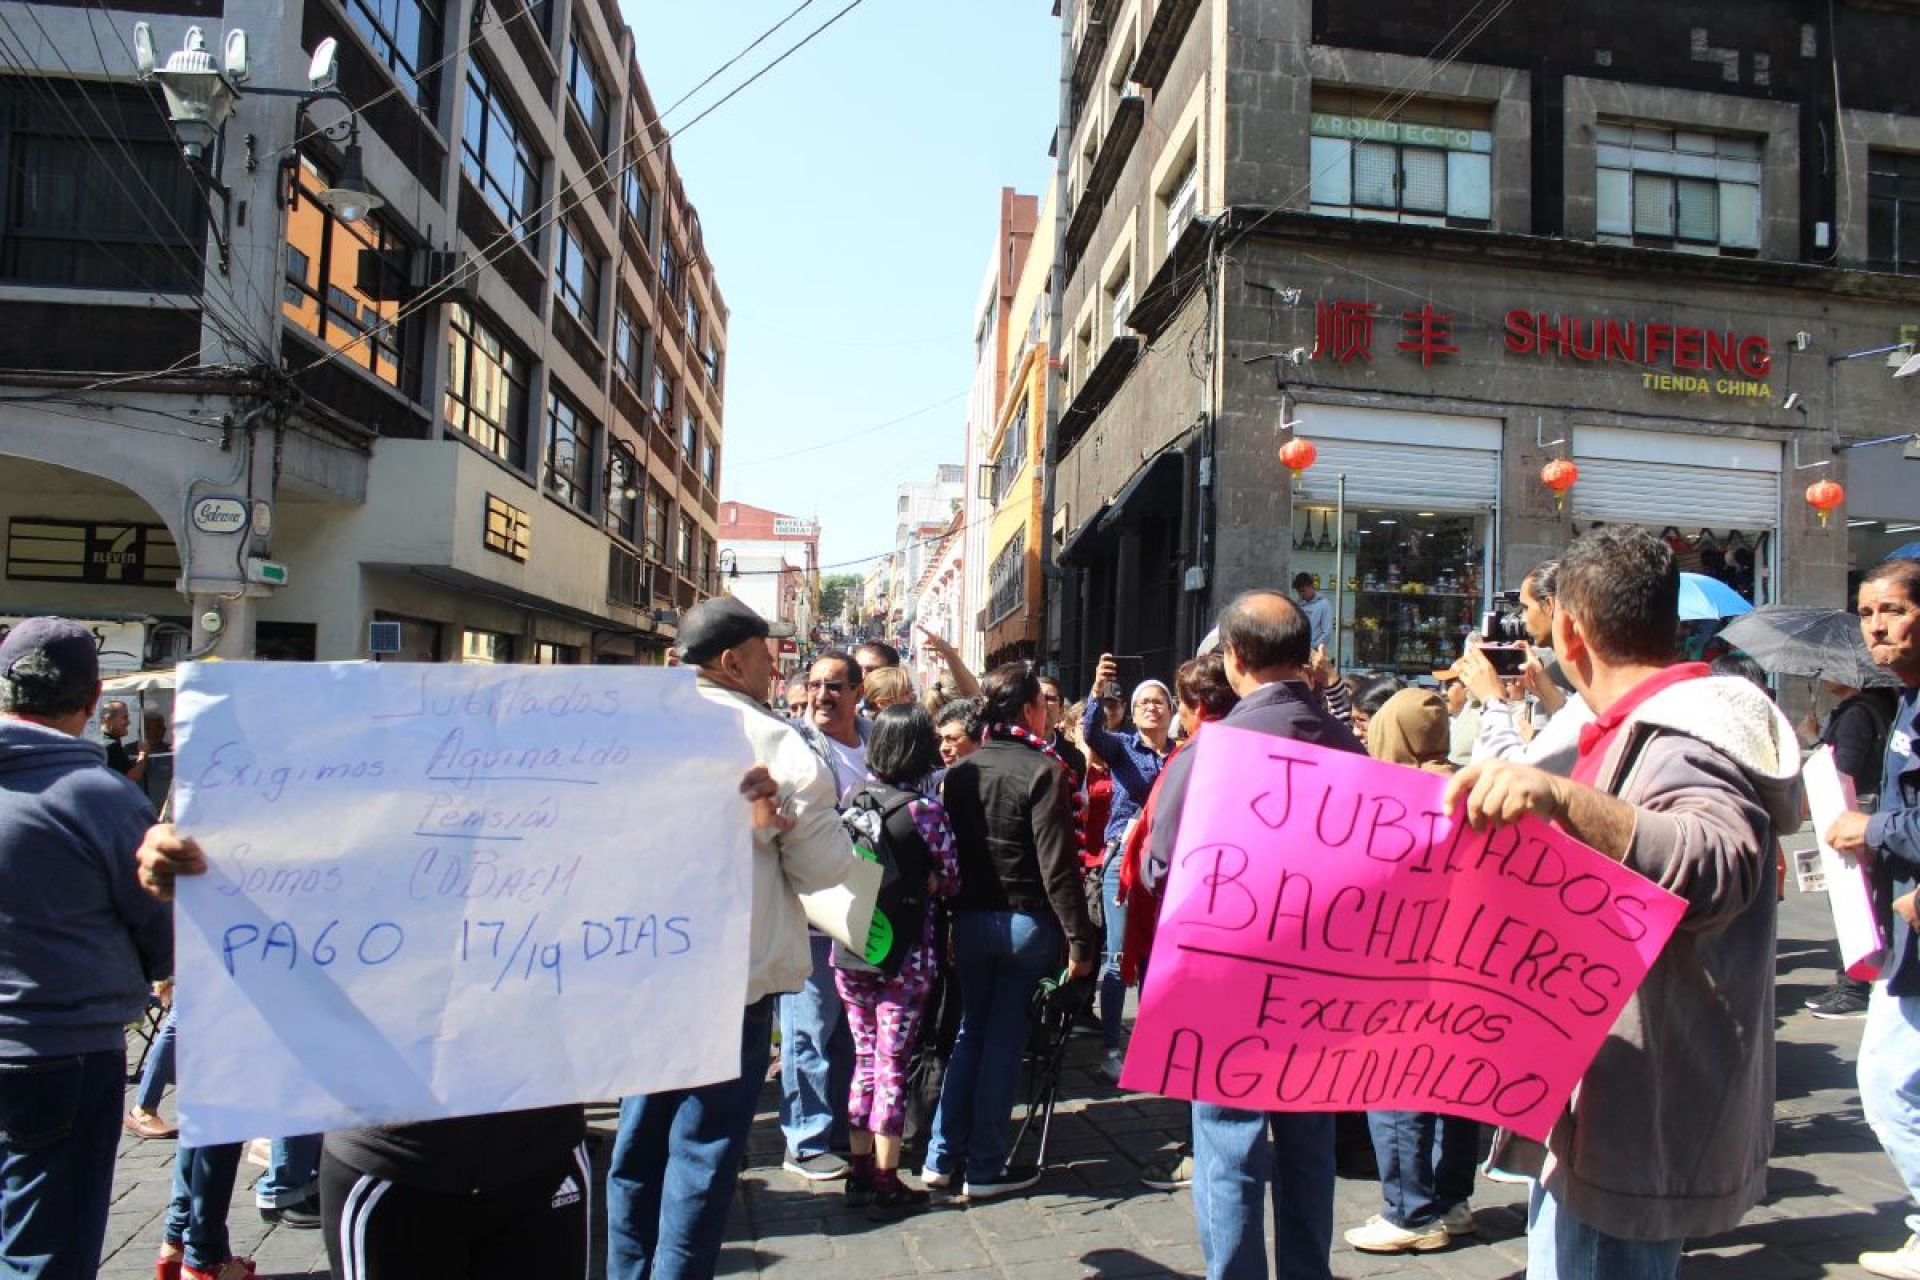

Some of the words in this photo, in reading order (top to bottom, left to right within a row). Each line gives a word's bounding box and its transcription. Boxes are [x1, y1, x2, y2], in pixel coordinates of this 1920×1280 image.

[1313, 300, 1460, 372] 顺丰
[1641, 372, 1710, 393] TIENDA
[1715, 378, 1771, 398] CHINA
[424, 726, 632, 790] Aguinaldo
[1249, 753, 1649, 943] JUBILADOS
[581, 915, 692, 962] DIAS
[1177, 842, 1623, 1018] BACHILLERES
[1256, 973, 1513, 1043] EXIGIMOS
[1159, 1028, 1550, 1118] AGUINALDO
